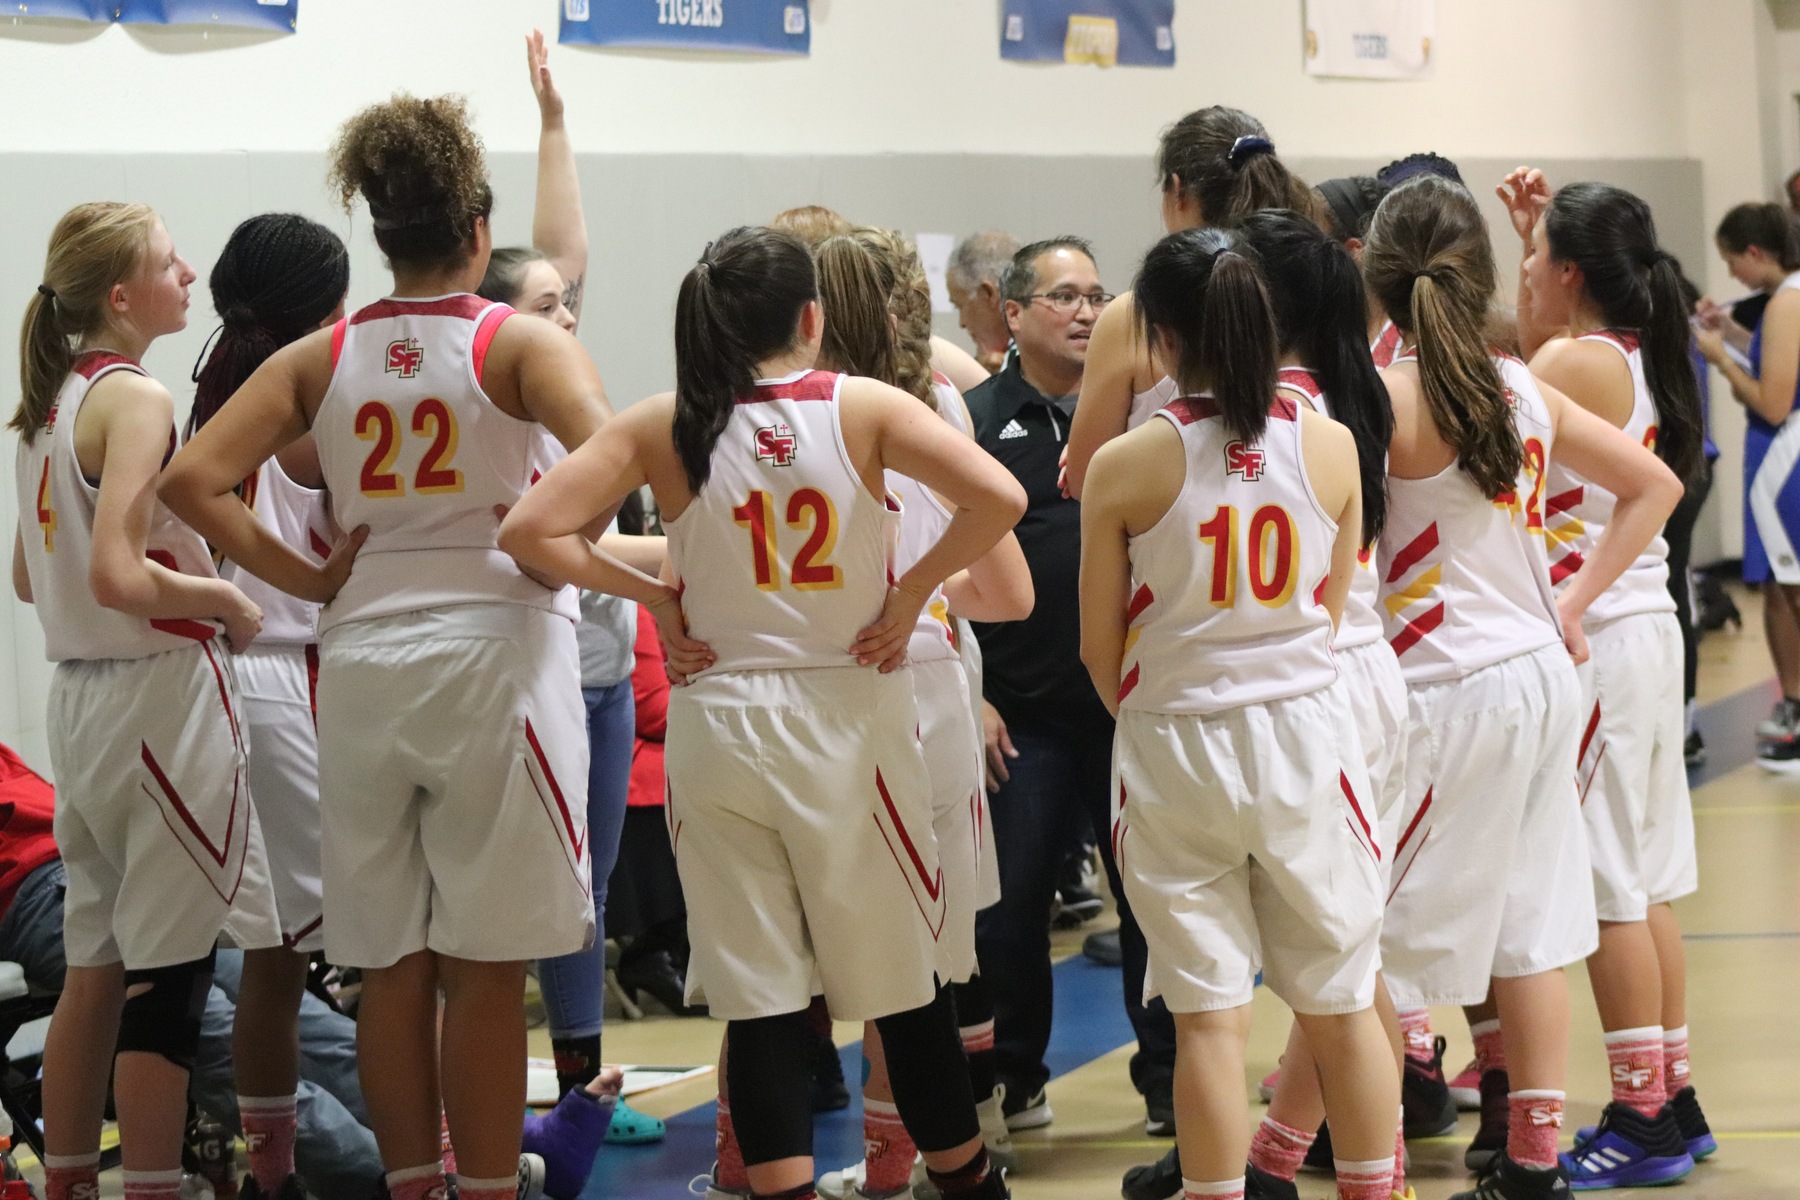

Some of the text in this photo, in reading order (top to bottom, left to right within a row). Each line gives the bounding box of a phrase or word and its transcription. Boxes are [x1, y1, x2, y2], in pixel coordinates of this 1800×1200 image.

[656, 0, 723, 27] TIGERS
[387, 341, 421, 377] SF
[355, 398, 465, 498] 22
[756, 428, 796, 465] SF
[999, 429, 1028, 440] adidas
[1225, 441, 1265, 480] SF
[37, 455, 58, 553] 4
[732, 487, 844, 593] 12
[1198, 504, 1300, 610] 10
[1612, 1063, 1654, 1089] SF
[203, 1139, 221, 1161] G
